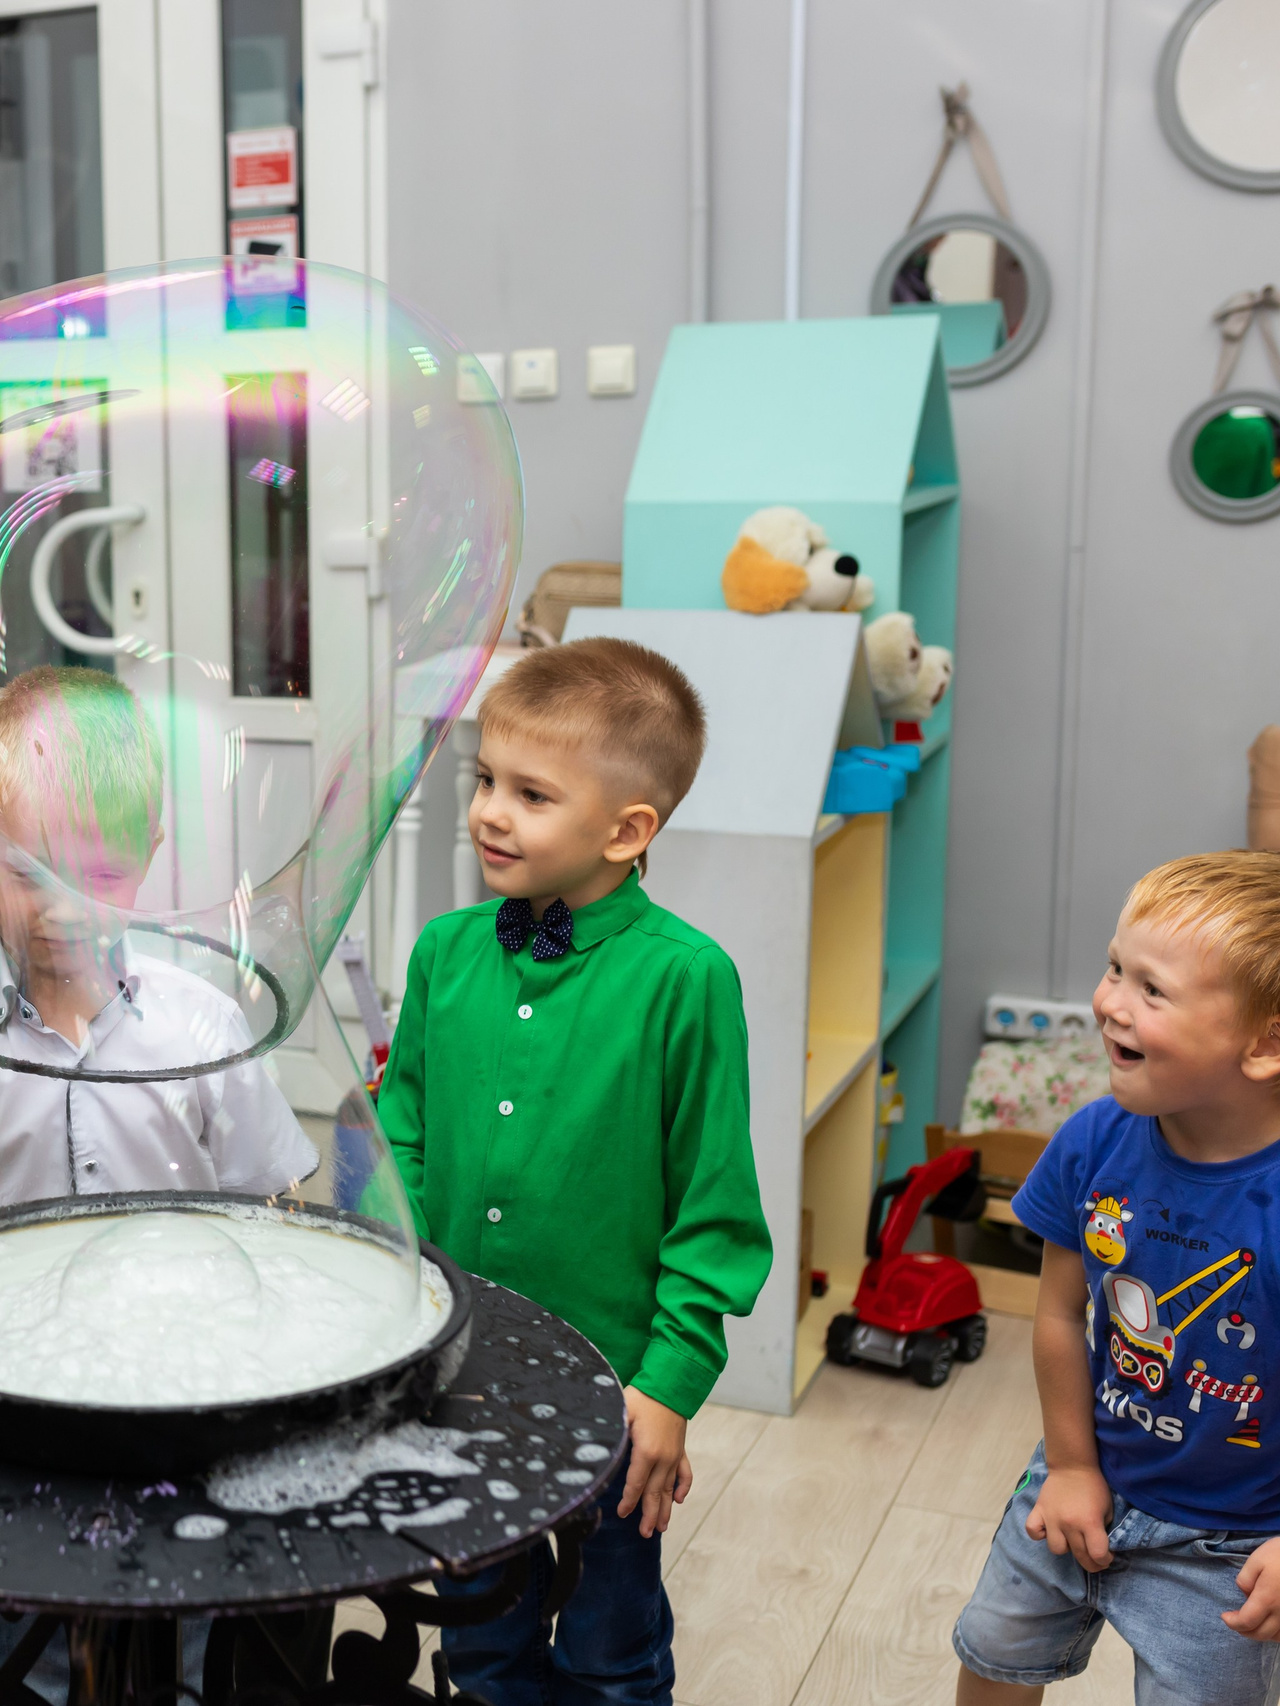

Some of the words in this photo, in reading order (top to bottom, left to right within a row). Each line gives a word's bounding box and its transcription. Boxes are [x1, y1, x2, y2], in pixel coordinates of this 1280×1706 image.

[1145, 1228, 1210, 1253] WORKER
[1192, 1374, 1253, 1398] Project
[1101, 1378, 1184, 1443] KIDS
